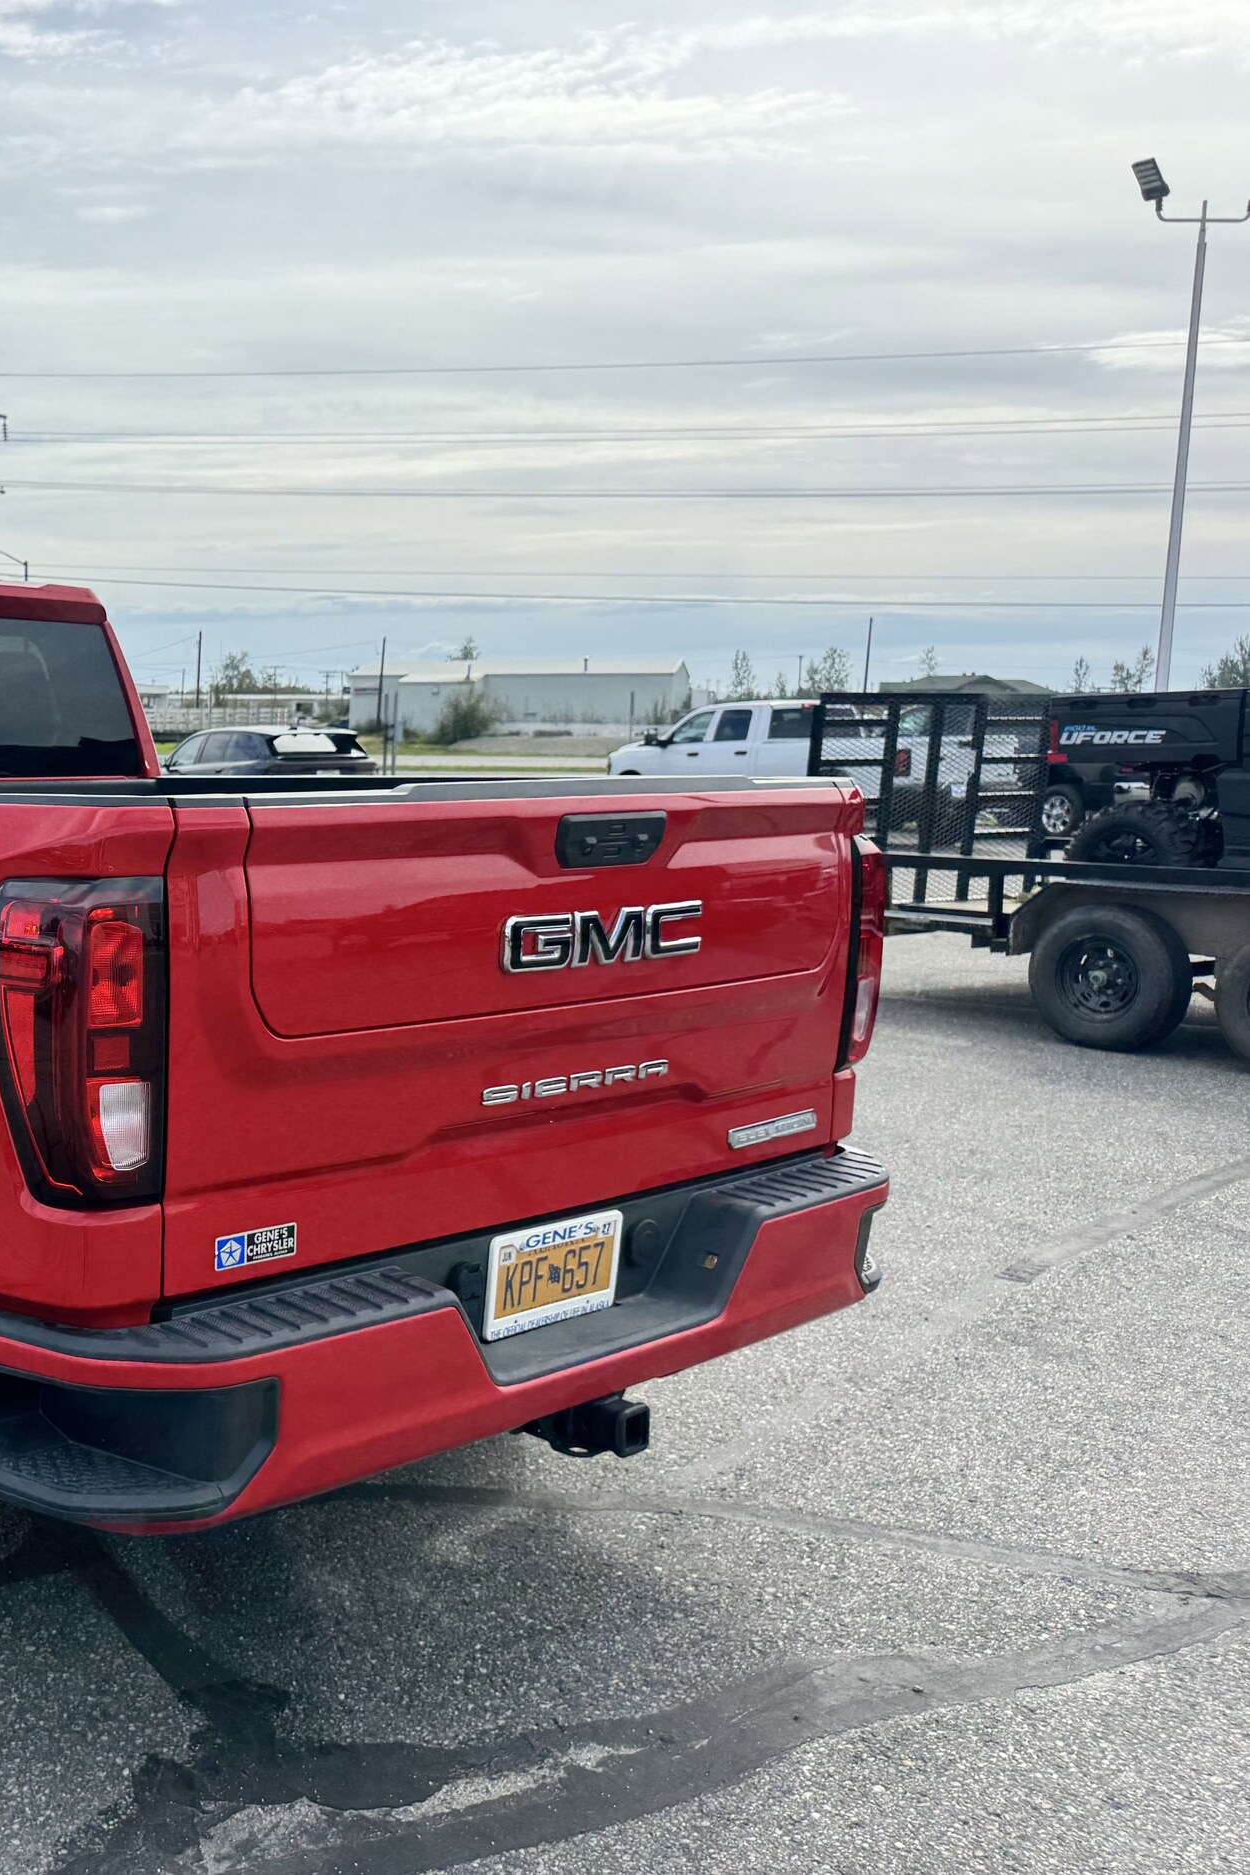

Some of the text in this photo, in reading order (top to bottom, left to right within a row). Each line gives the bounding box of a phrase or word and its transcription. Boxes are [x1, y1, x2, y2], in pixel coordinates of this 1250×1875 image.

[1059, 730, 1167, 745] UFORCE
[503, 900, 703, 973] GMC
[481, 1059, 669, 1106] SIERRA
[247, 1237, 294, 1257] CHRYSLER
[254, 1227, 288, 1244] GENE'S
[525, 1221, 594, 1248] GENE'S
[502, 1241, 606, 1311] KPF 657
